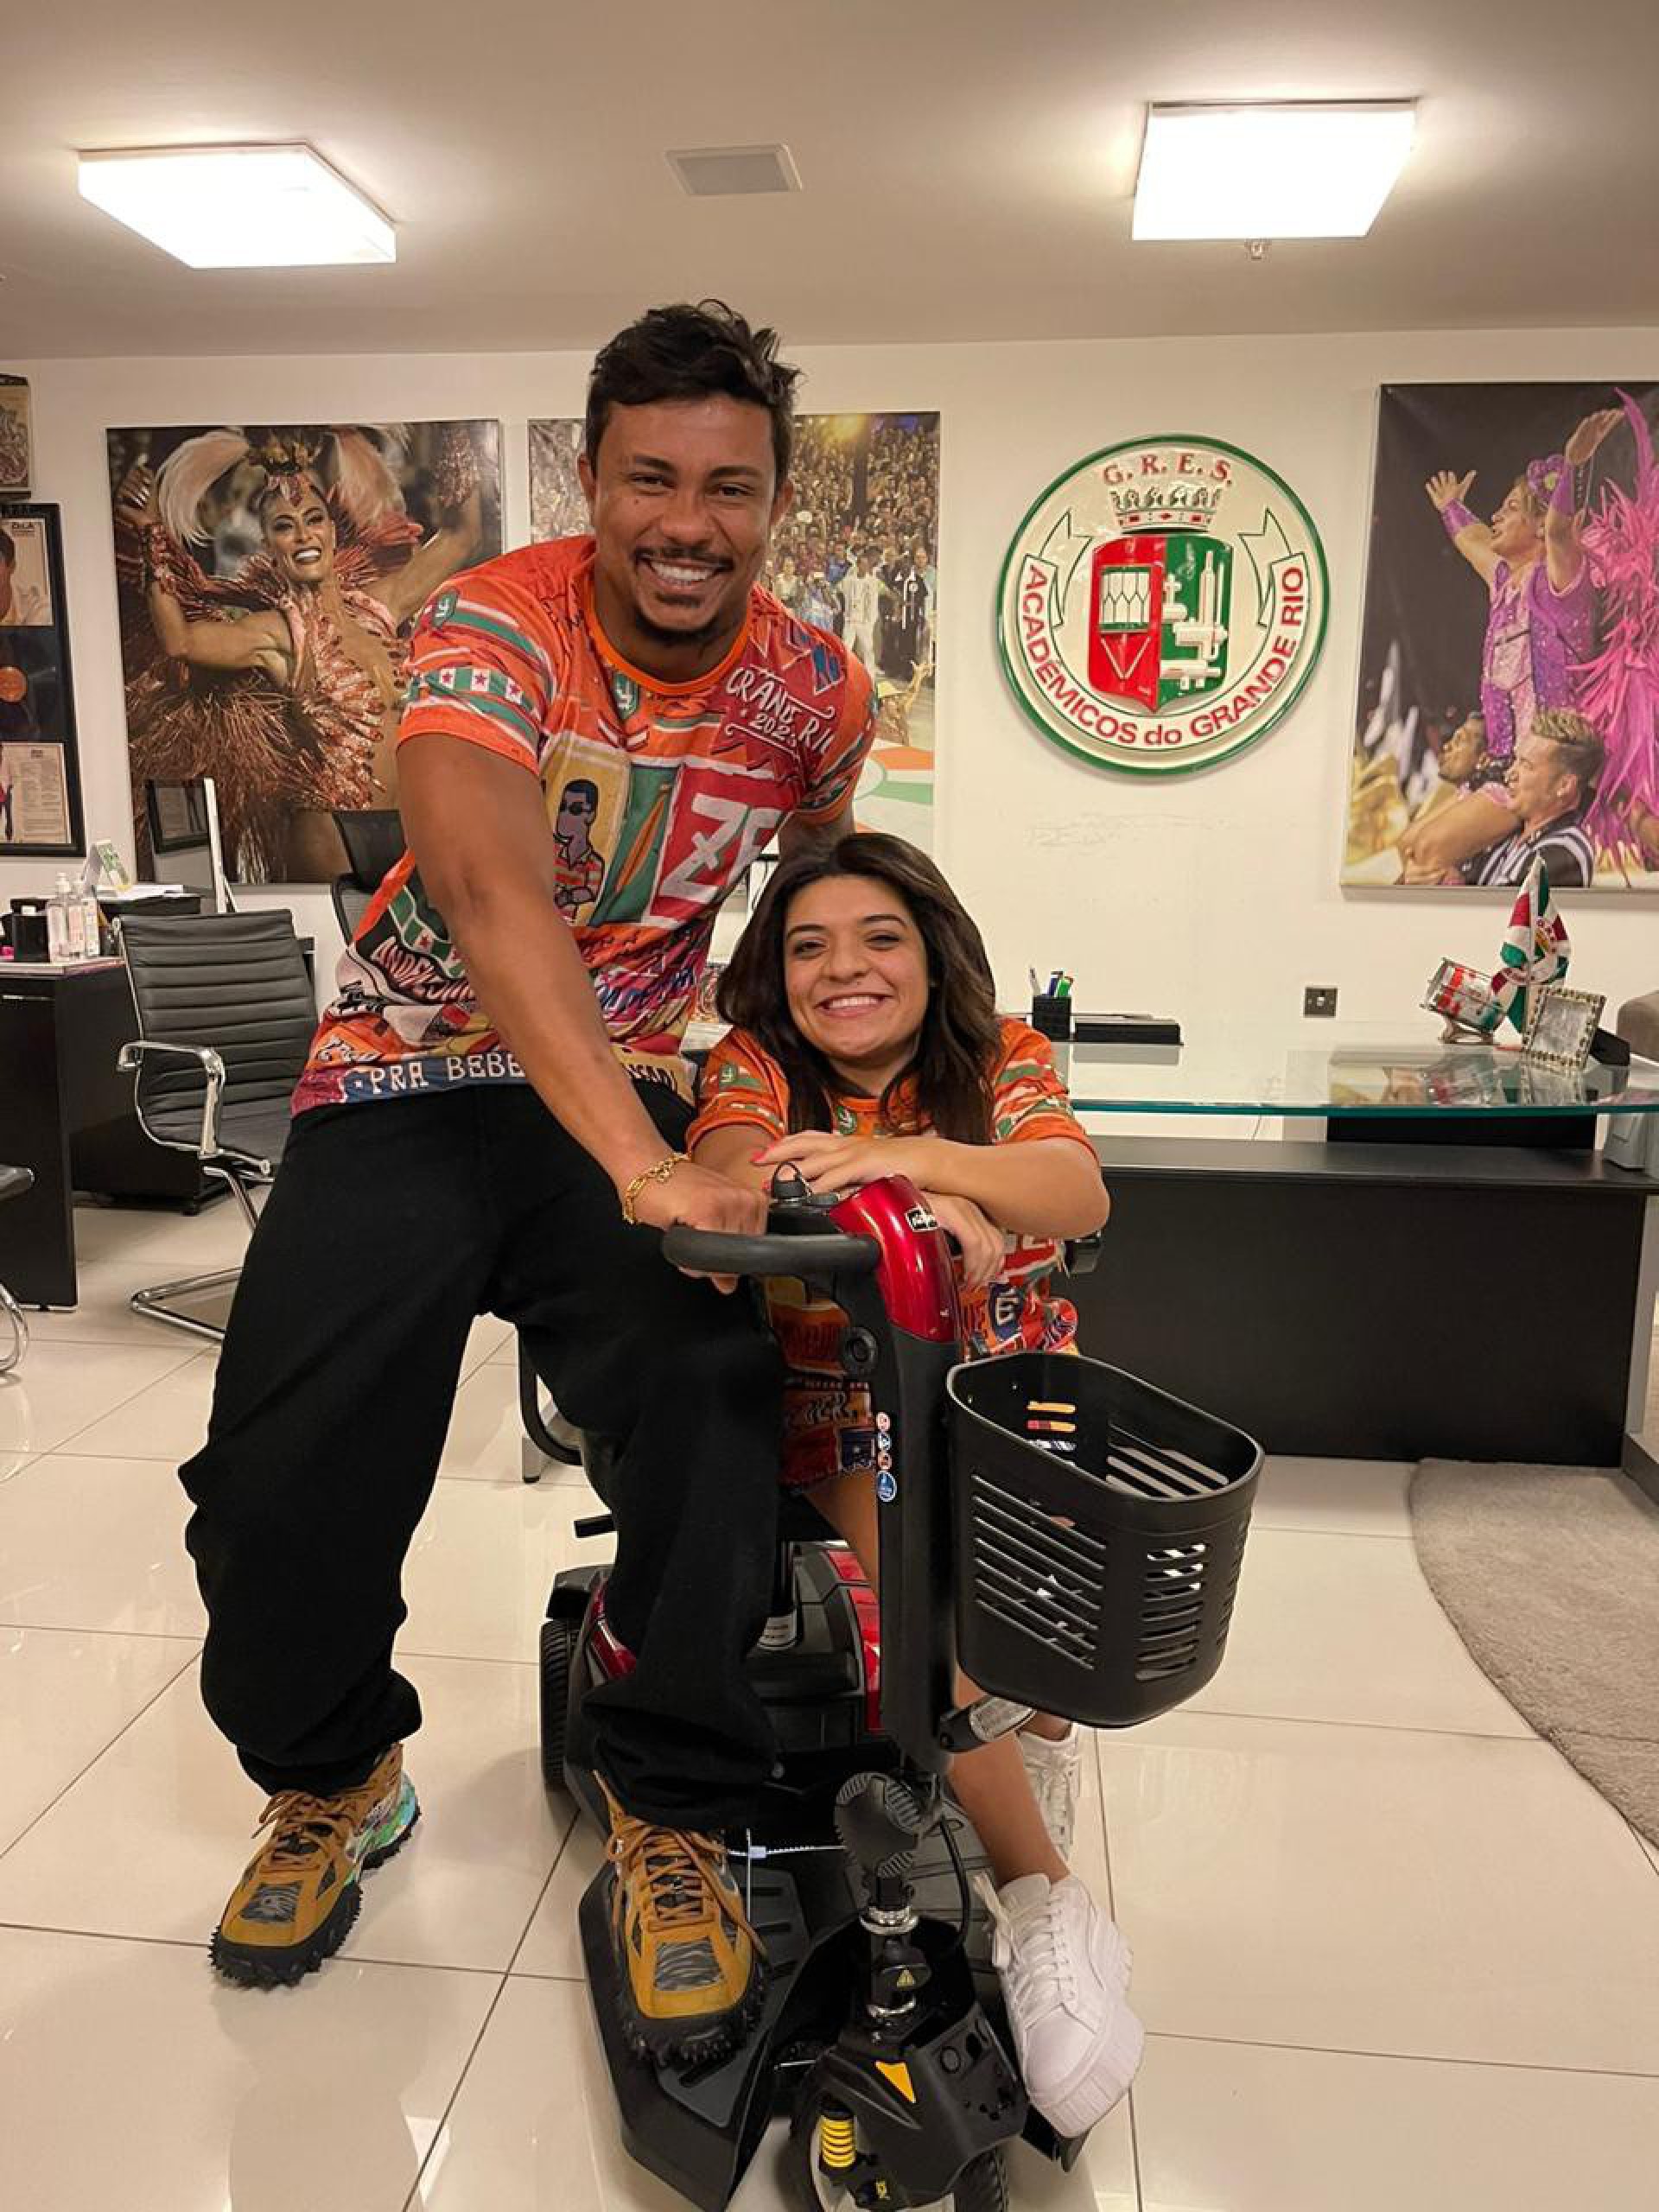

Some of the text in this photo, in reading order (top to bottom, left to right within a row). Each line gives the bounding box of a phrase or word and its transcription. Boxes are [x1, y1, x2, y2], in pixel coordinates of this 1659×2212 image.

[1144, 724, 1182, 746] do
[1190, 635, 1298, 738] GRANDE
[1281, 567, 1304, 626] RIO
[369, 1061, 429, 1095] PRA
